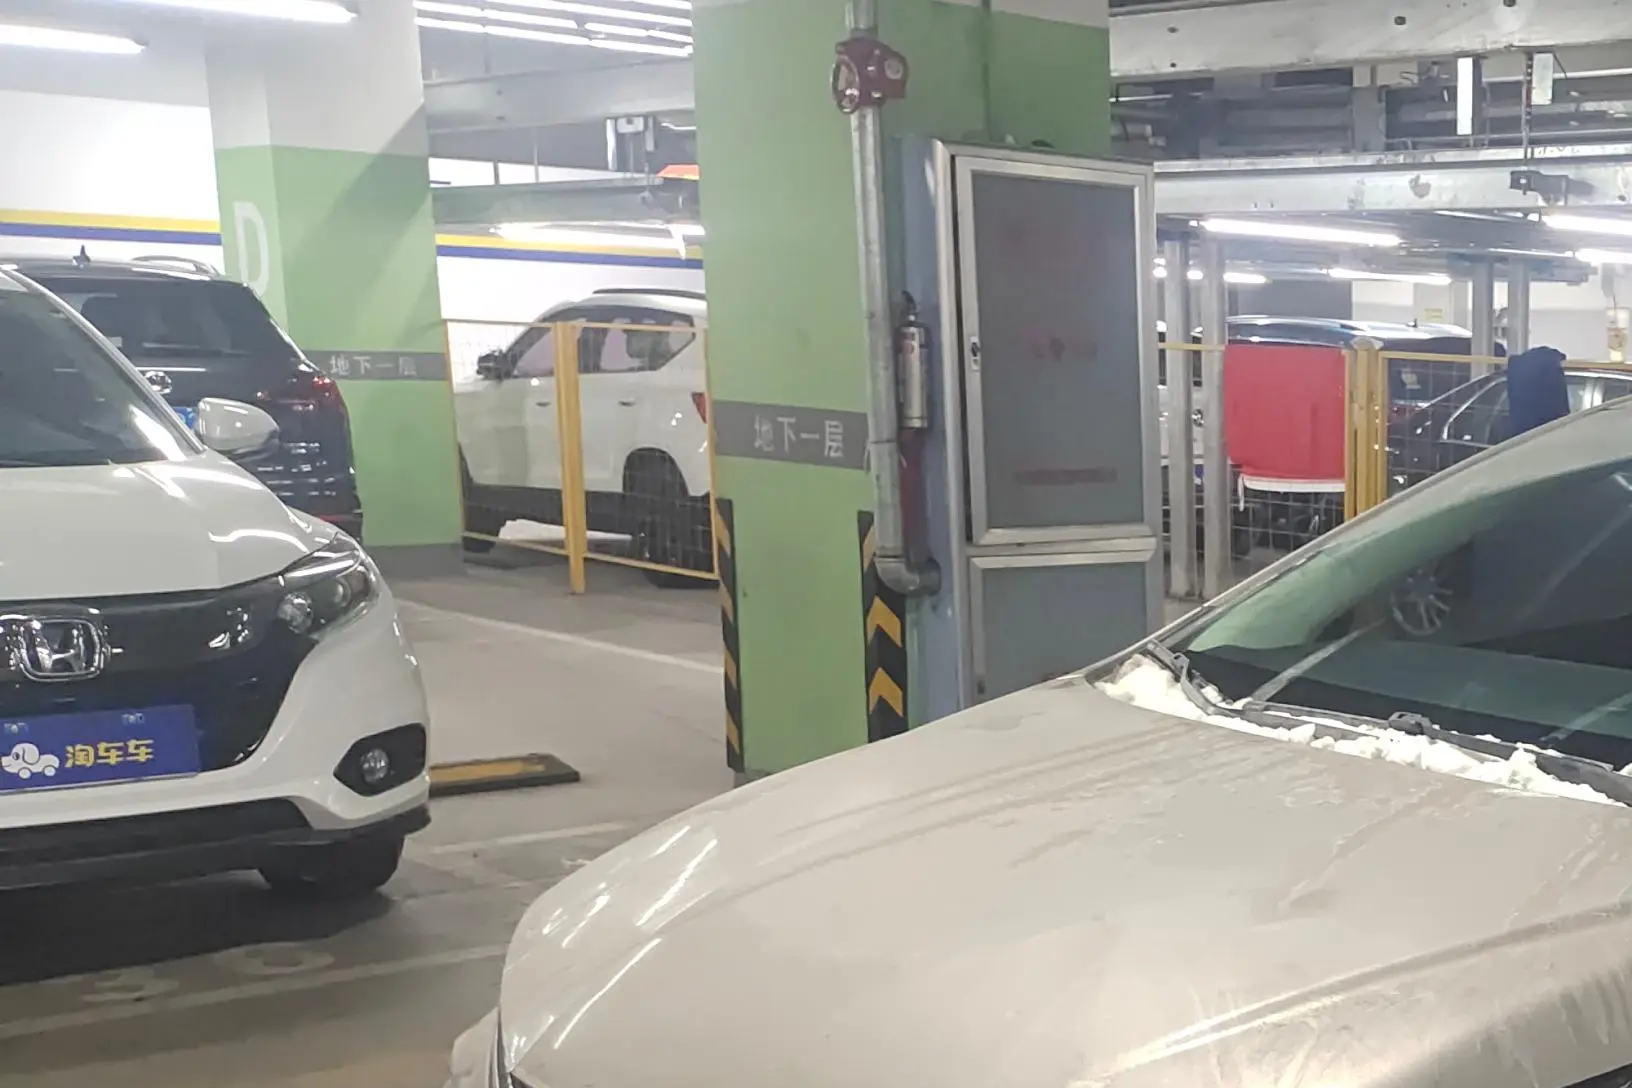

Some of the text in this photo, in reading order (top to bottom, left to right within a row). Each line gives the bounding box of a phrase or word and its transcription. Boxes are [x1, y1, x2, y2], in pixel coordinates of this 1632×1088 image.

[753, 413, 844, 457] 地下一层
[64, 738, 154, 768] 淘车车
